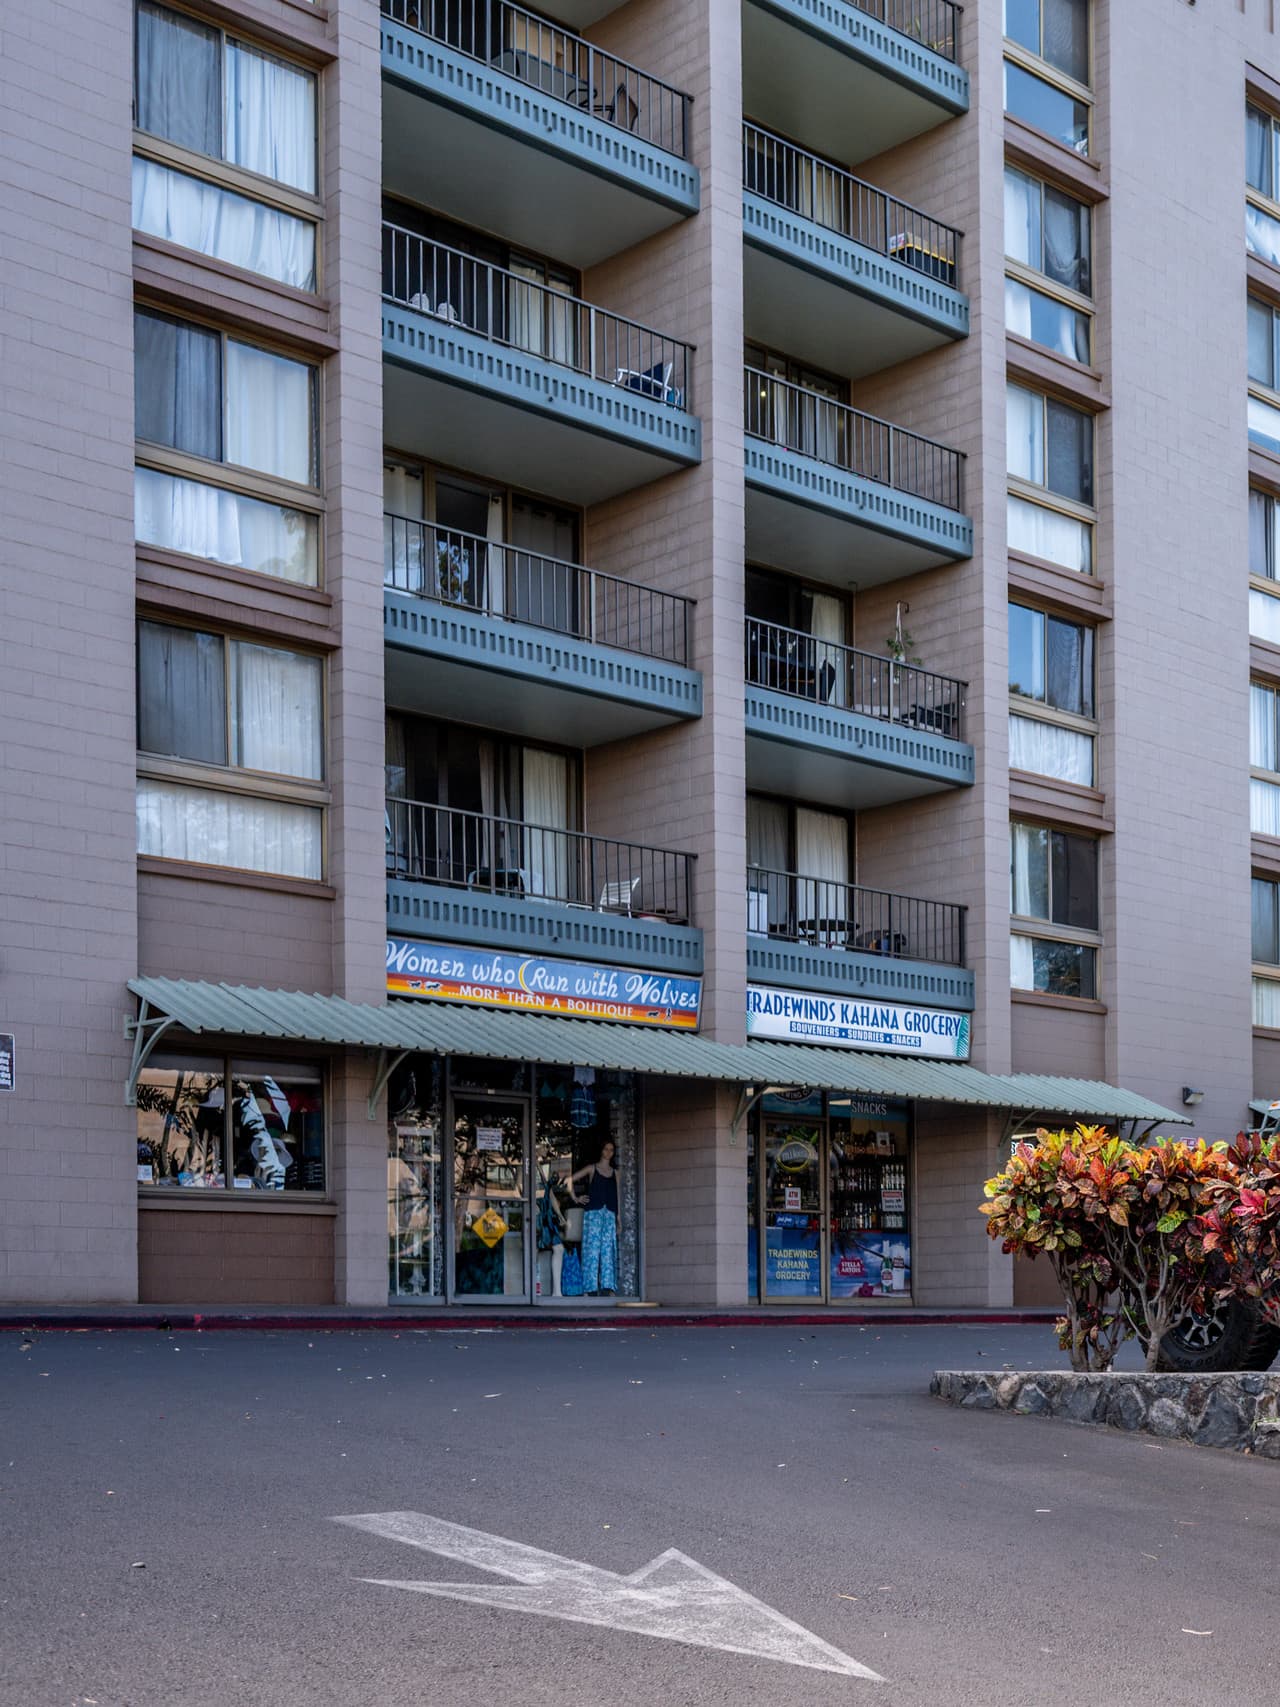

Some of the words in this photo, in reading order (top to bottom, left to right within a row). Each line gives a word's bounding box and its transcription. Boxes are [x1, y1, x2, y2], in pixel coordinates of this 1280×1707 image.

[386, 941, 465, 978] Women
[472, 956, 515, 985] who
[529, 965, 569, 992] Run
[575, 971, 618, 998] with
[625, 975, 698, 1009] Wolves
[505, 992, 545, 1007] THAN
[551, 997, 561, 1009] A
[567, 999, 633, 1019] BOUTIQUE
[746, 990, 835, 1022] TRADEWINDS
[841, 1002, 899, 1031] KAHANA
[904, 1011, 961, 1037] GROCERY
[791, 1022, 839, 1038] SOUVENIERS
[847, 1031, 884, 1043] SUNDRIES
[891, 1036, 921, 1048] SNACKS
[851, 1101, 887, 1116] SNACKS
[768, 1249, 818, 1258] TRADEWINDS
[777, 1260, 809, 1269] KAHANA
[775, 1271, 811, 1281] GROCERY
